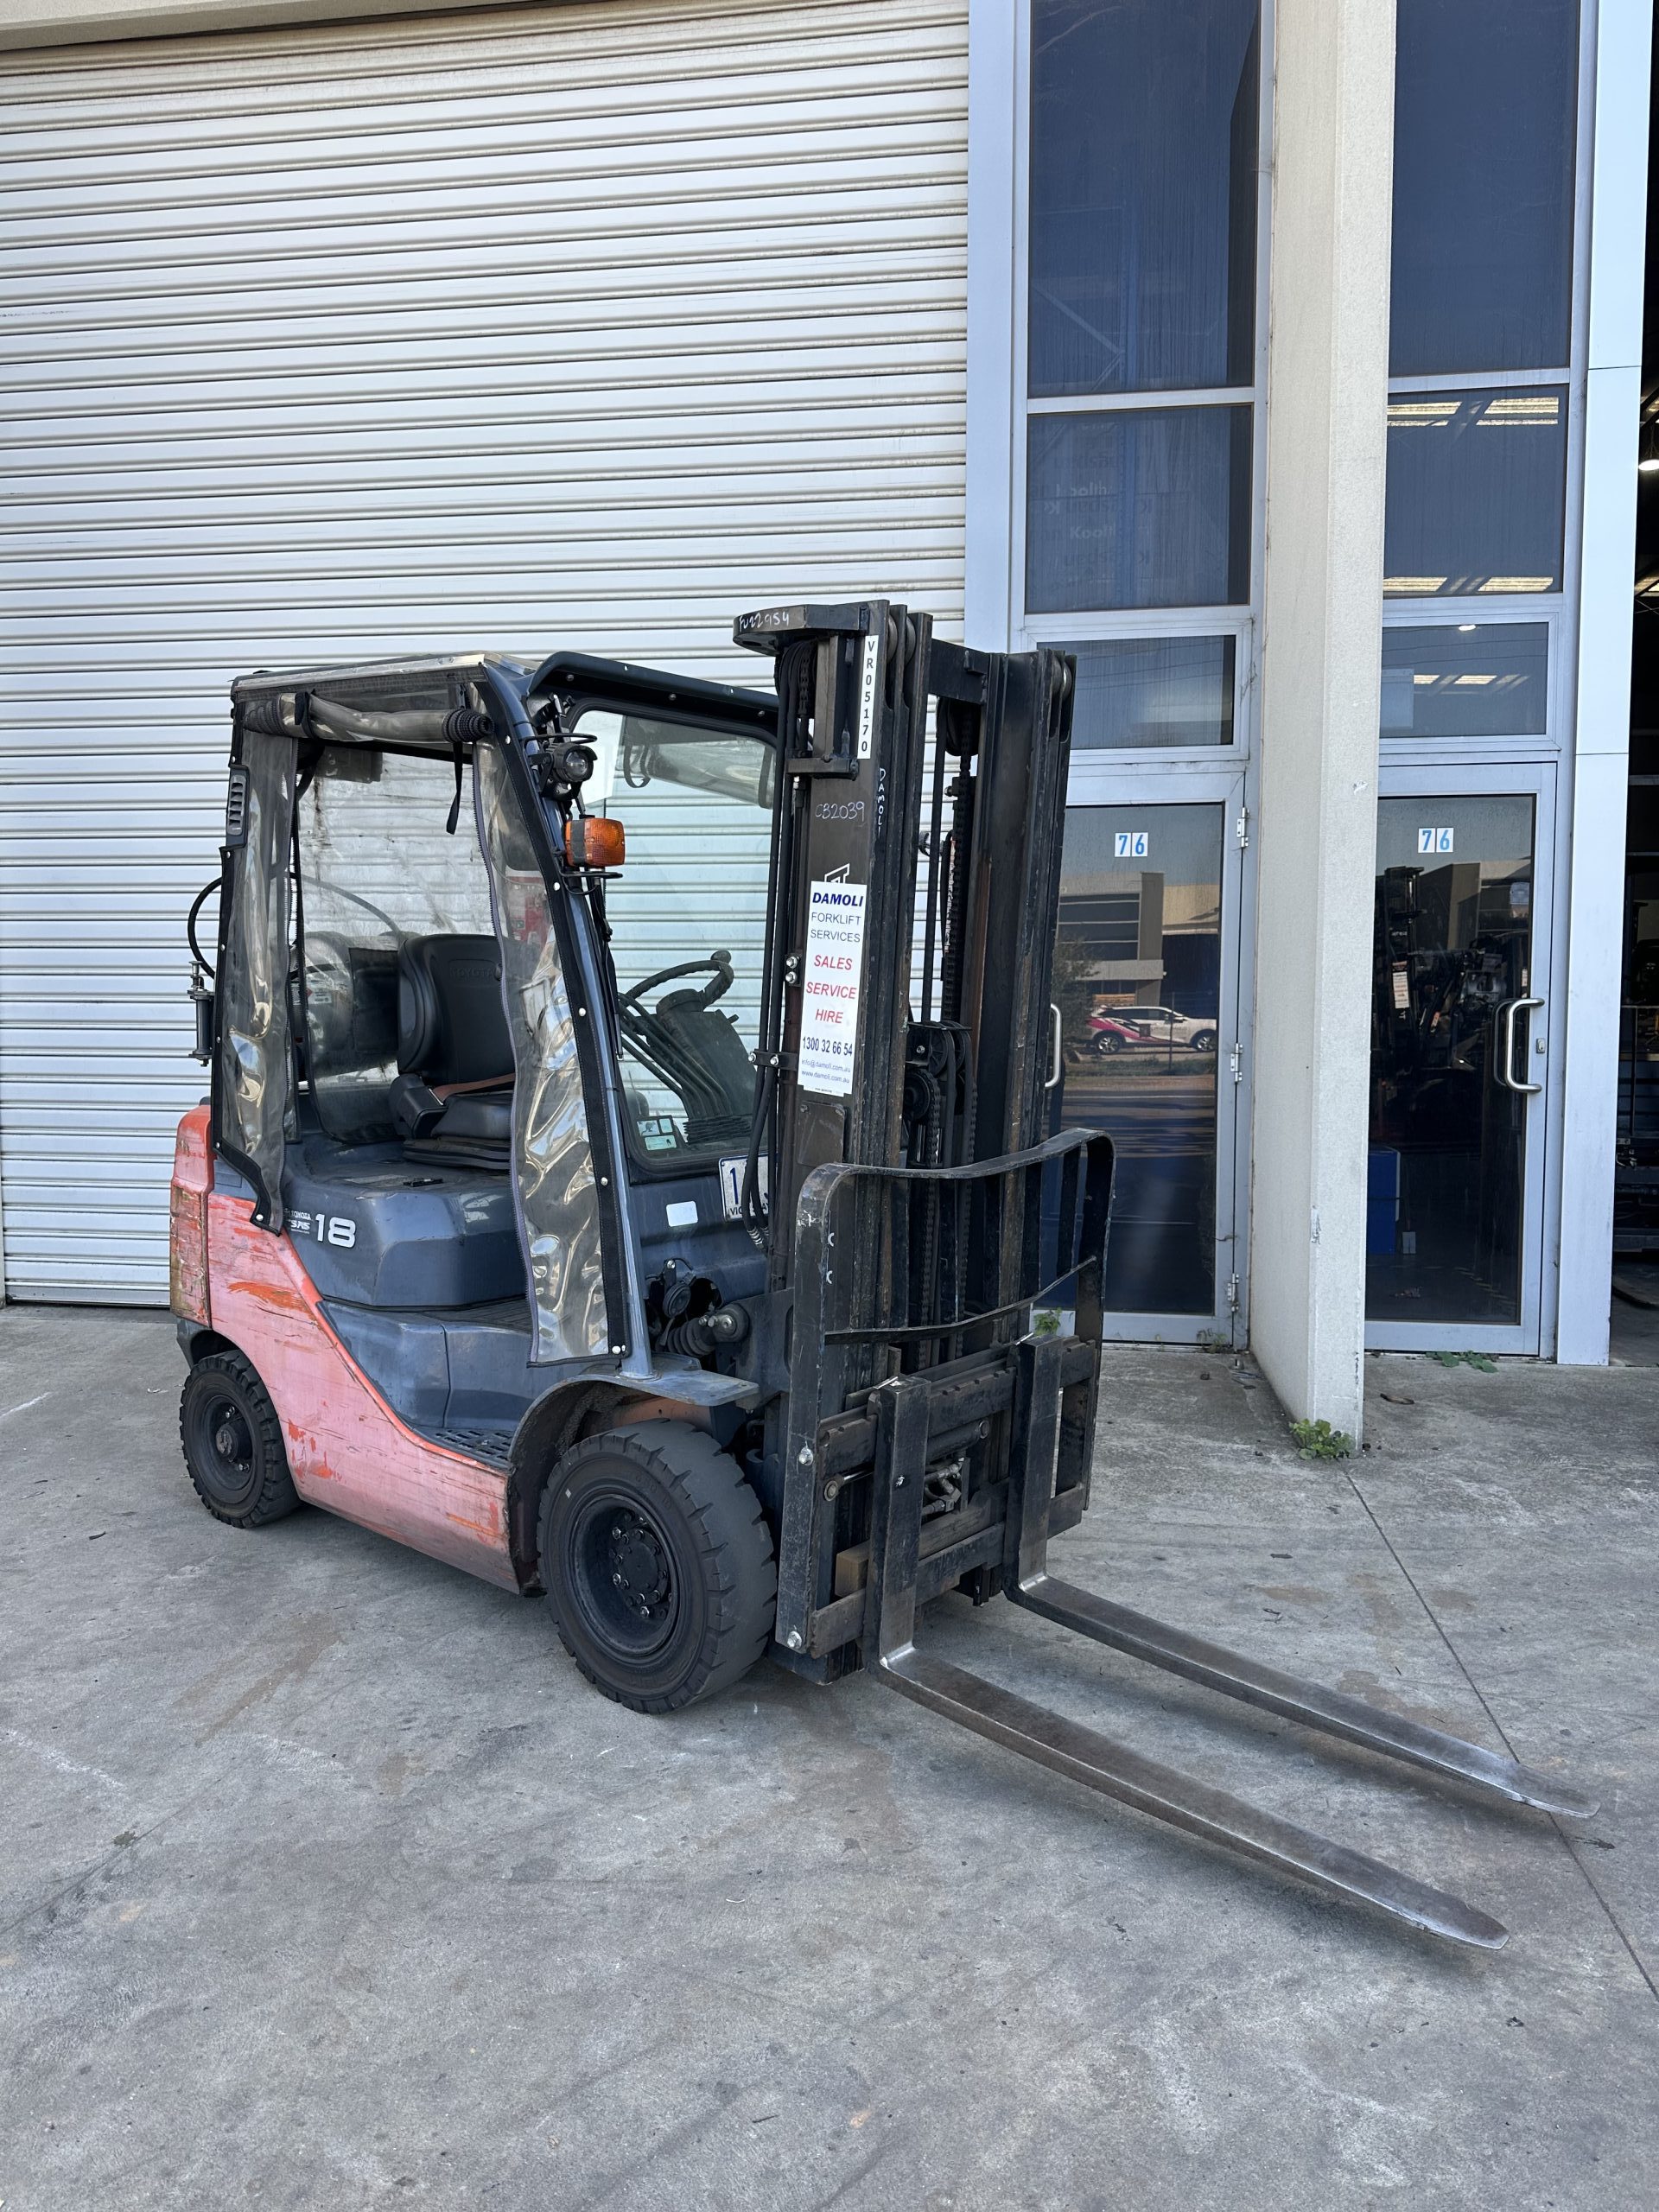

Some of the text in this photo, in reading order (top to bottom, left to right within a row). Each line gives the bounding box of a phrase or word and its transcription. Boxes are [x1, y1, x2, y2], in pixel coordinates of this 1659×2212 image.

[861, 640, 875, 752] VR05170
[1118, 834, 1145, 855] 76
[1422, 829, 1450, 851] 76
[812, 892, 864, 907] DAMOLI
[811, 912, 861, 925] FORKLIFT
[810, 929, 861, 943] SERVICES
[814, 955, 853, 970] SALES
[805, 982, 857, 1000] SERVICE
[815, 1008, 844, 1024] HIRE
[803, 1036, 853, 1057] 1300 32 66 54
[801, 1071, 850, 1084] www.damoli.com.au
[315, 1213, 356, 1249] 18
